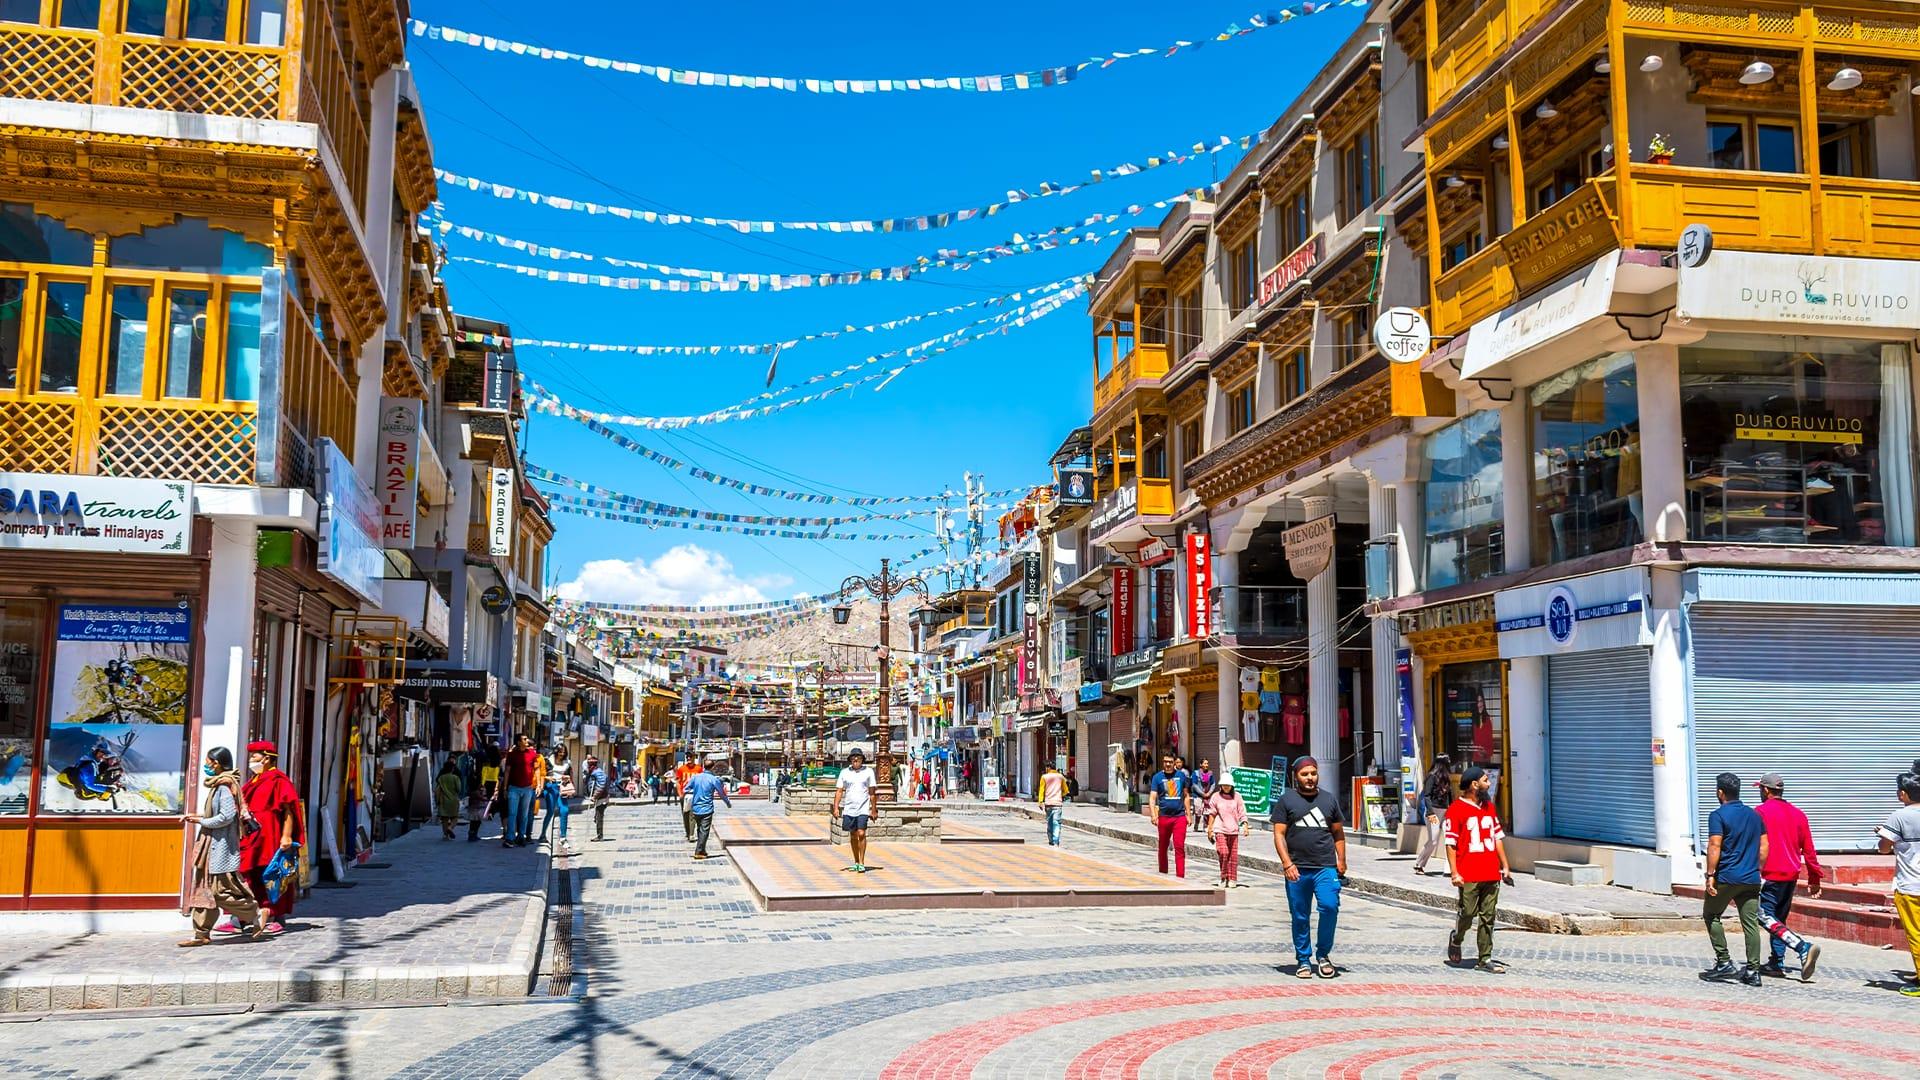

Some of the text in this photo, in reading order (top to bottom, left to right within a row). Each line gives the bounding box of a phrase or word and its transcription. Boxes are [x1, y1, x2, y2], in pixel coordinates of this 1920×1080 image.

[1567, 197, 1603, 229] CAFE
[1742, 288, 1909, 310] DURO RUVIDO
[1534, 301, 1576, 327] RUVIDO
[1386, 338, 1424, 357] coffee
[1735, 414, 1862, 432] DURORUVIDO
[385, 442, 407, 516] BRAZIL
[83, 500, 182, 520] travels
[496, 488, 506, 545] RABSAL
[54, 522, 64, 536] in
[68, 523, 101, 537] Trans
[104, 524, 164, 542] Himalayas
[1289, 521, 1327, 545] MENGON
[1290, 541, 1327, 559] SHOPPING
[1195, 573, 1206, 637] PIZZA
[1552, 601, 1569, 618] SOL
[64, 609, 86, 620] World's
[86, 610, 108, 622] Highest
[143, 612, 175, 624] Paragliding
[175, 612, 187, 623] Site
[84, 623, 167, 635] Come Fly With Us
[1027, 616, 1035, 680] Travel
[450, 680, 481, 689] STORE
[1467, 816, 1495, 853] 13
